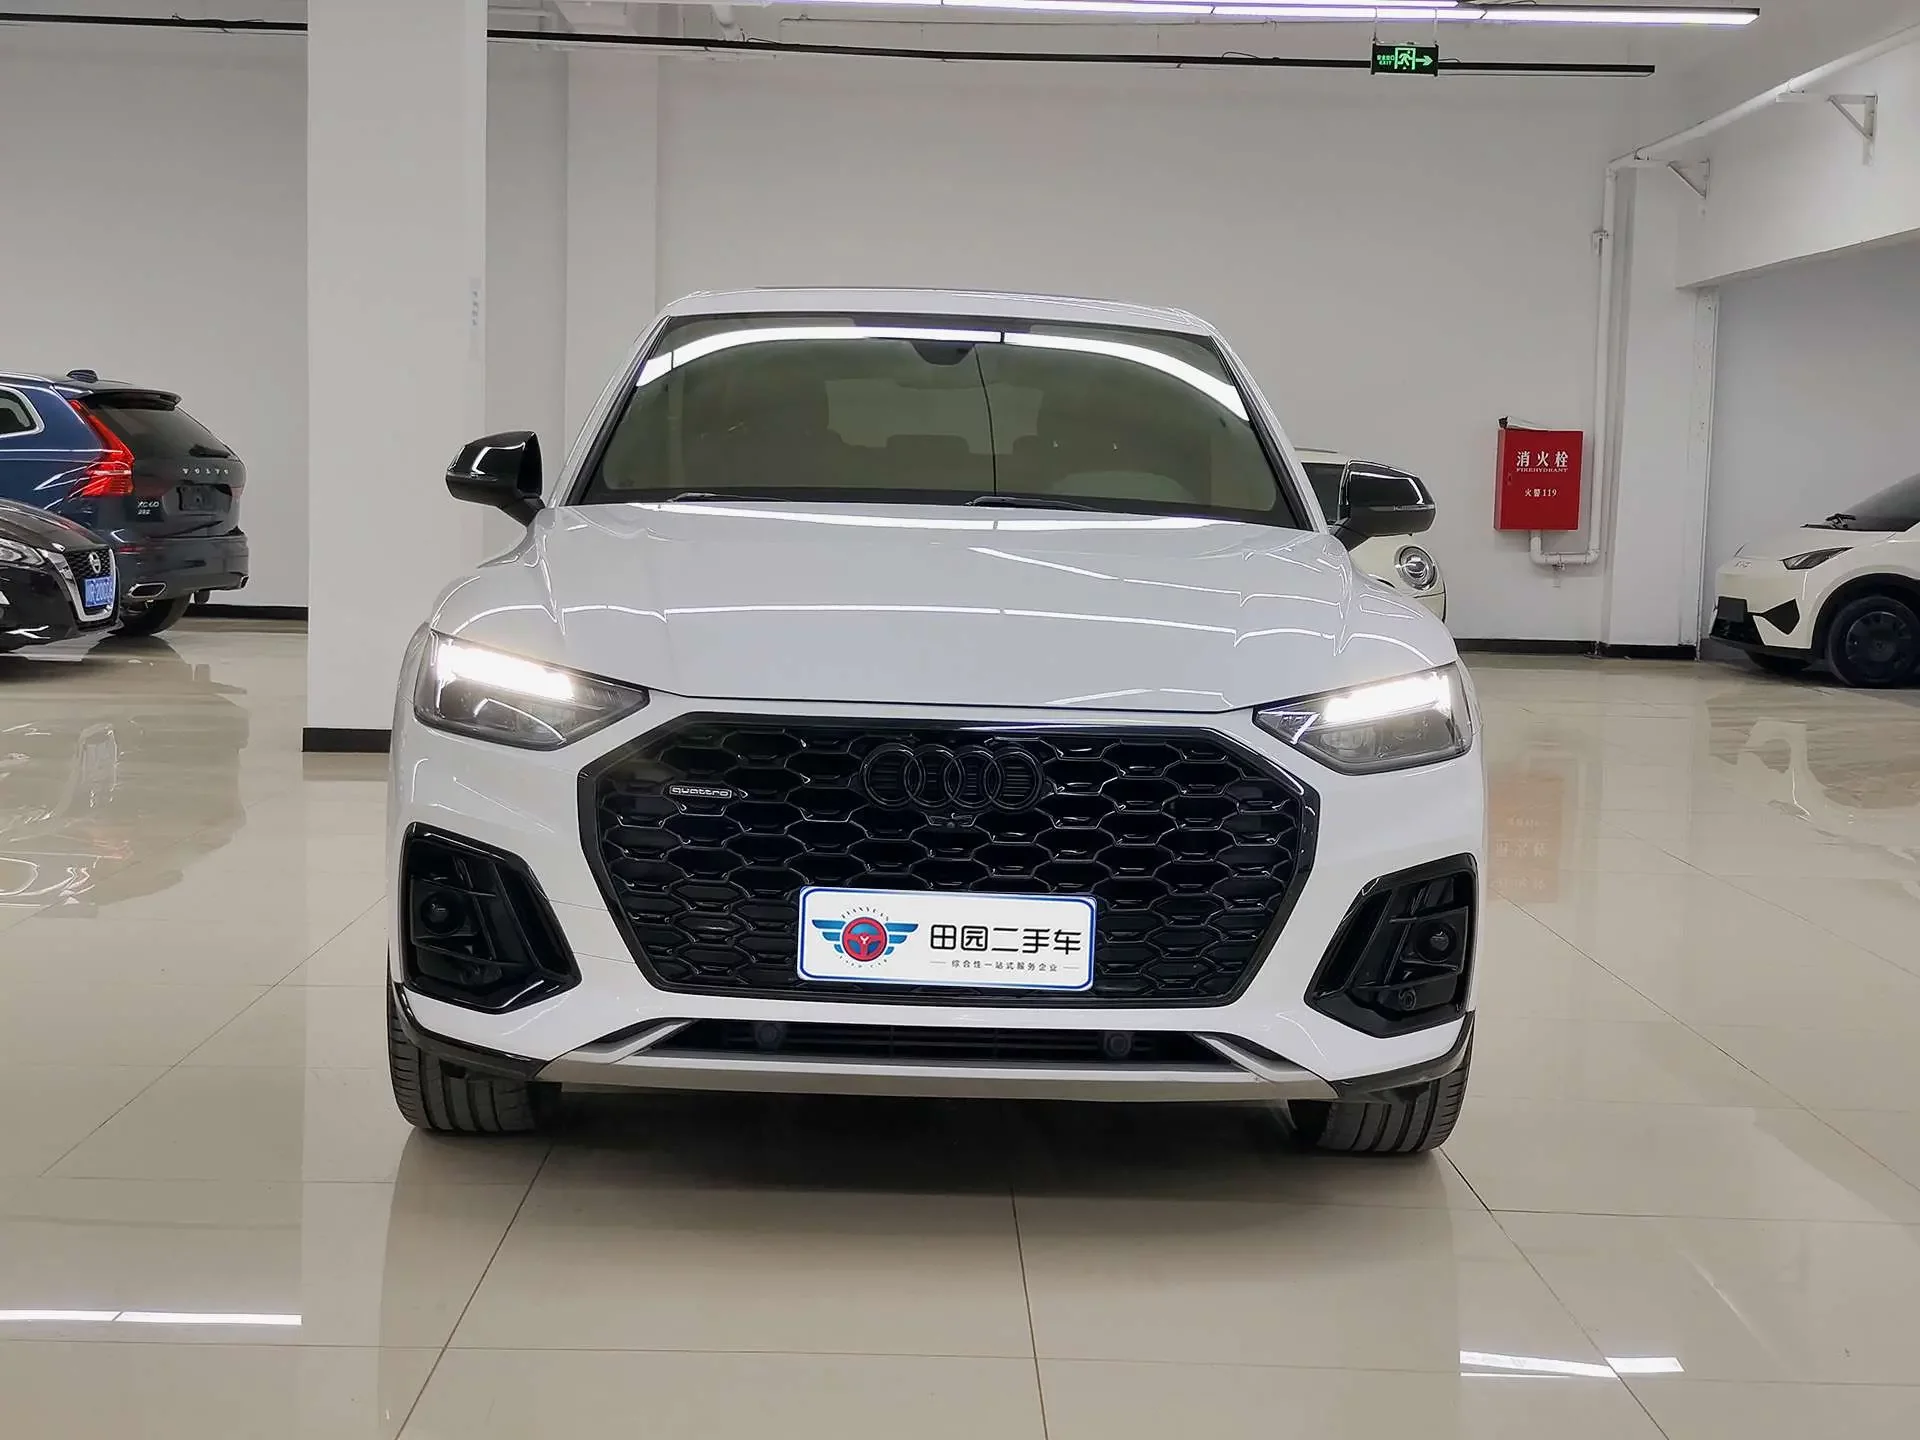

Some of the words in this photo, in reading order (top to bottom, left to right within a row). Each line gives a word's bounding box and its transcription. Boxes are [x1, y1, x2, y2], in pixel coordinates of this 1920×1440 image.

[1516, 450, 1569, 468] 消火栓
[671, 787, 729, 796] quattro
[930, 924, 1082, 955] 田园二手车
[951, 959, 1058, 972] 综合性一站式服务企业
